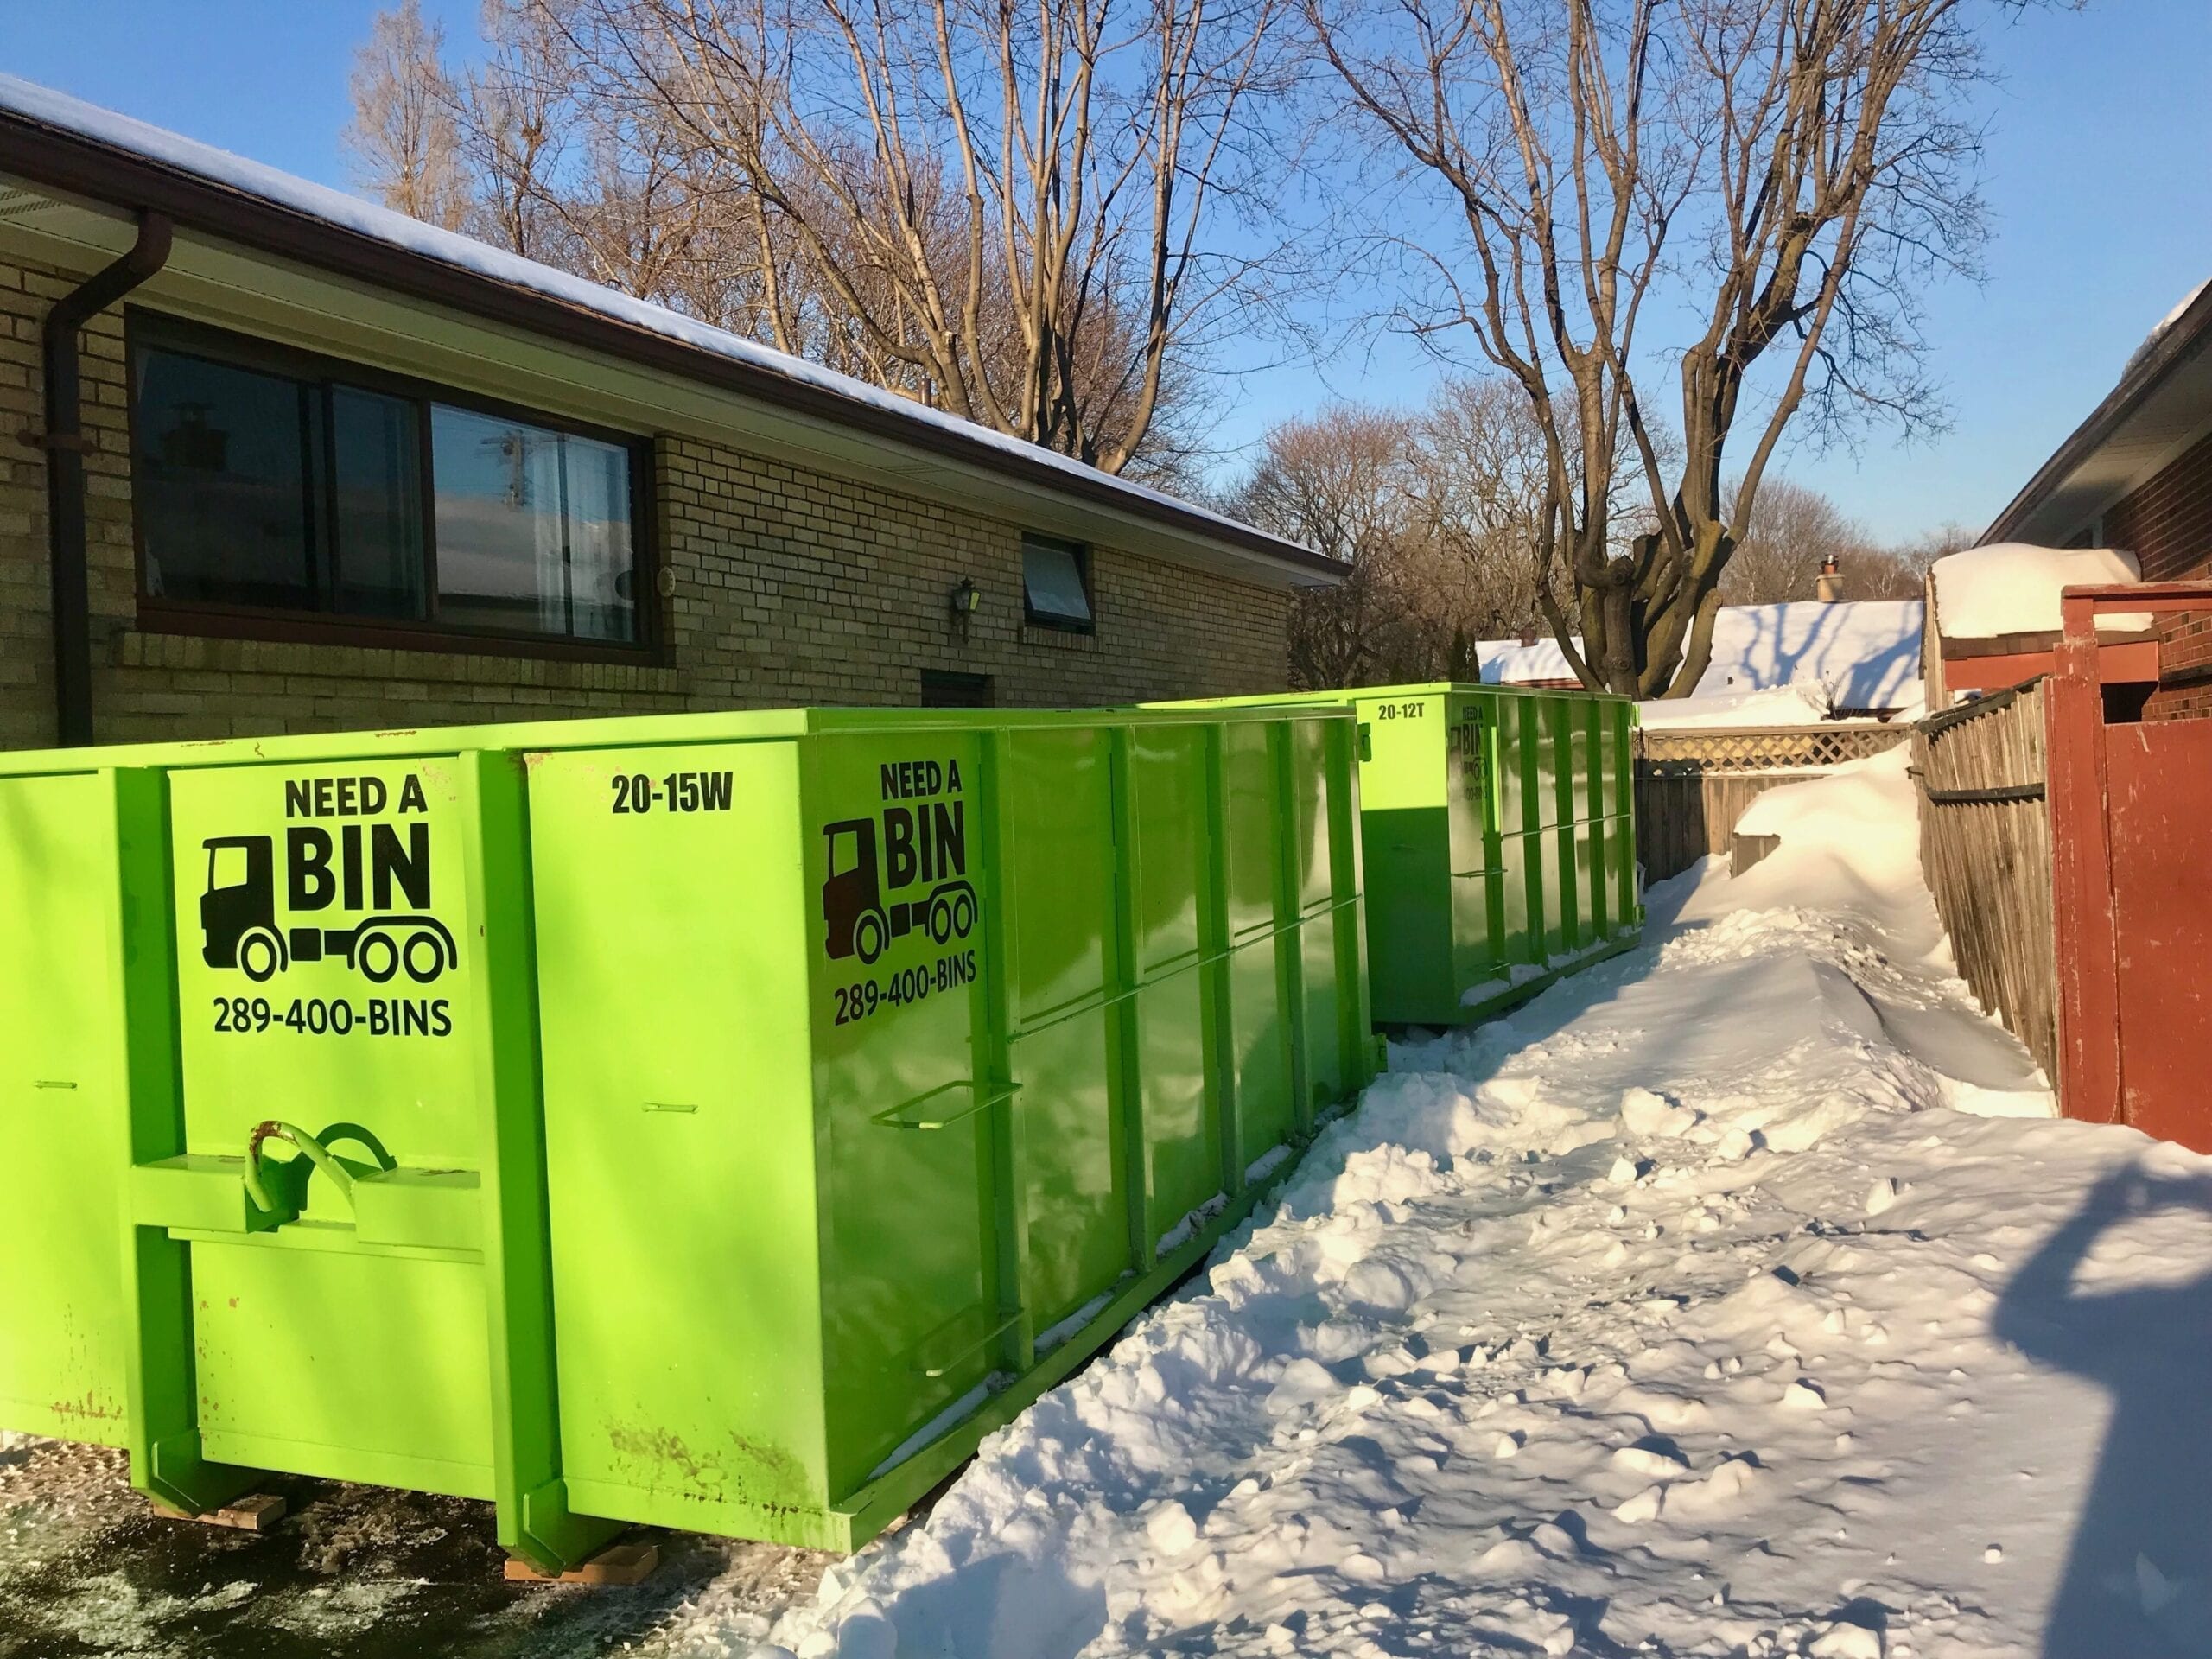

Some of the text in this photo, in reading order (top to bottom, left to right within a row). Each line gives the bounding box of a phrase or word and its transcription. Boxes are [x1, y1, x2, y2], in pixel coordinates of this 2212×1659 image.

[1378, 702, 1425, 720] 20-12T
[1462, 705, 1484, 721] NEED A
[285, 773, 429, 818] NEED A
[611, 771, 734, 814] 20-15W
[880, 759, 963, 801] NEED A
[883, 800, 966, 890] BIN
[286, 822, 432, 912] BIN
[834, 949, 976, 1027] 289-400-BINS
[213, 996, 453, 1038] 289-400-BINS
